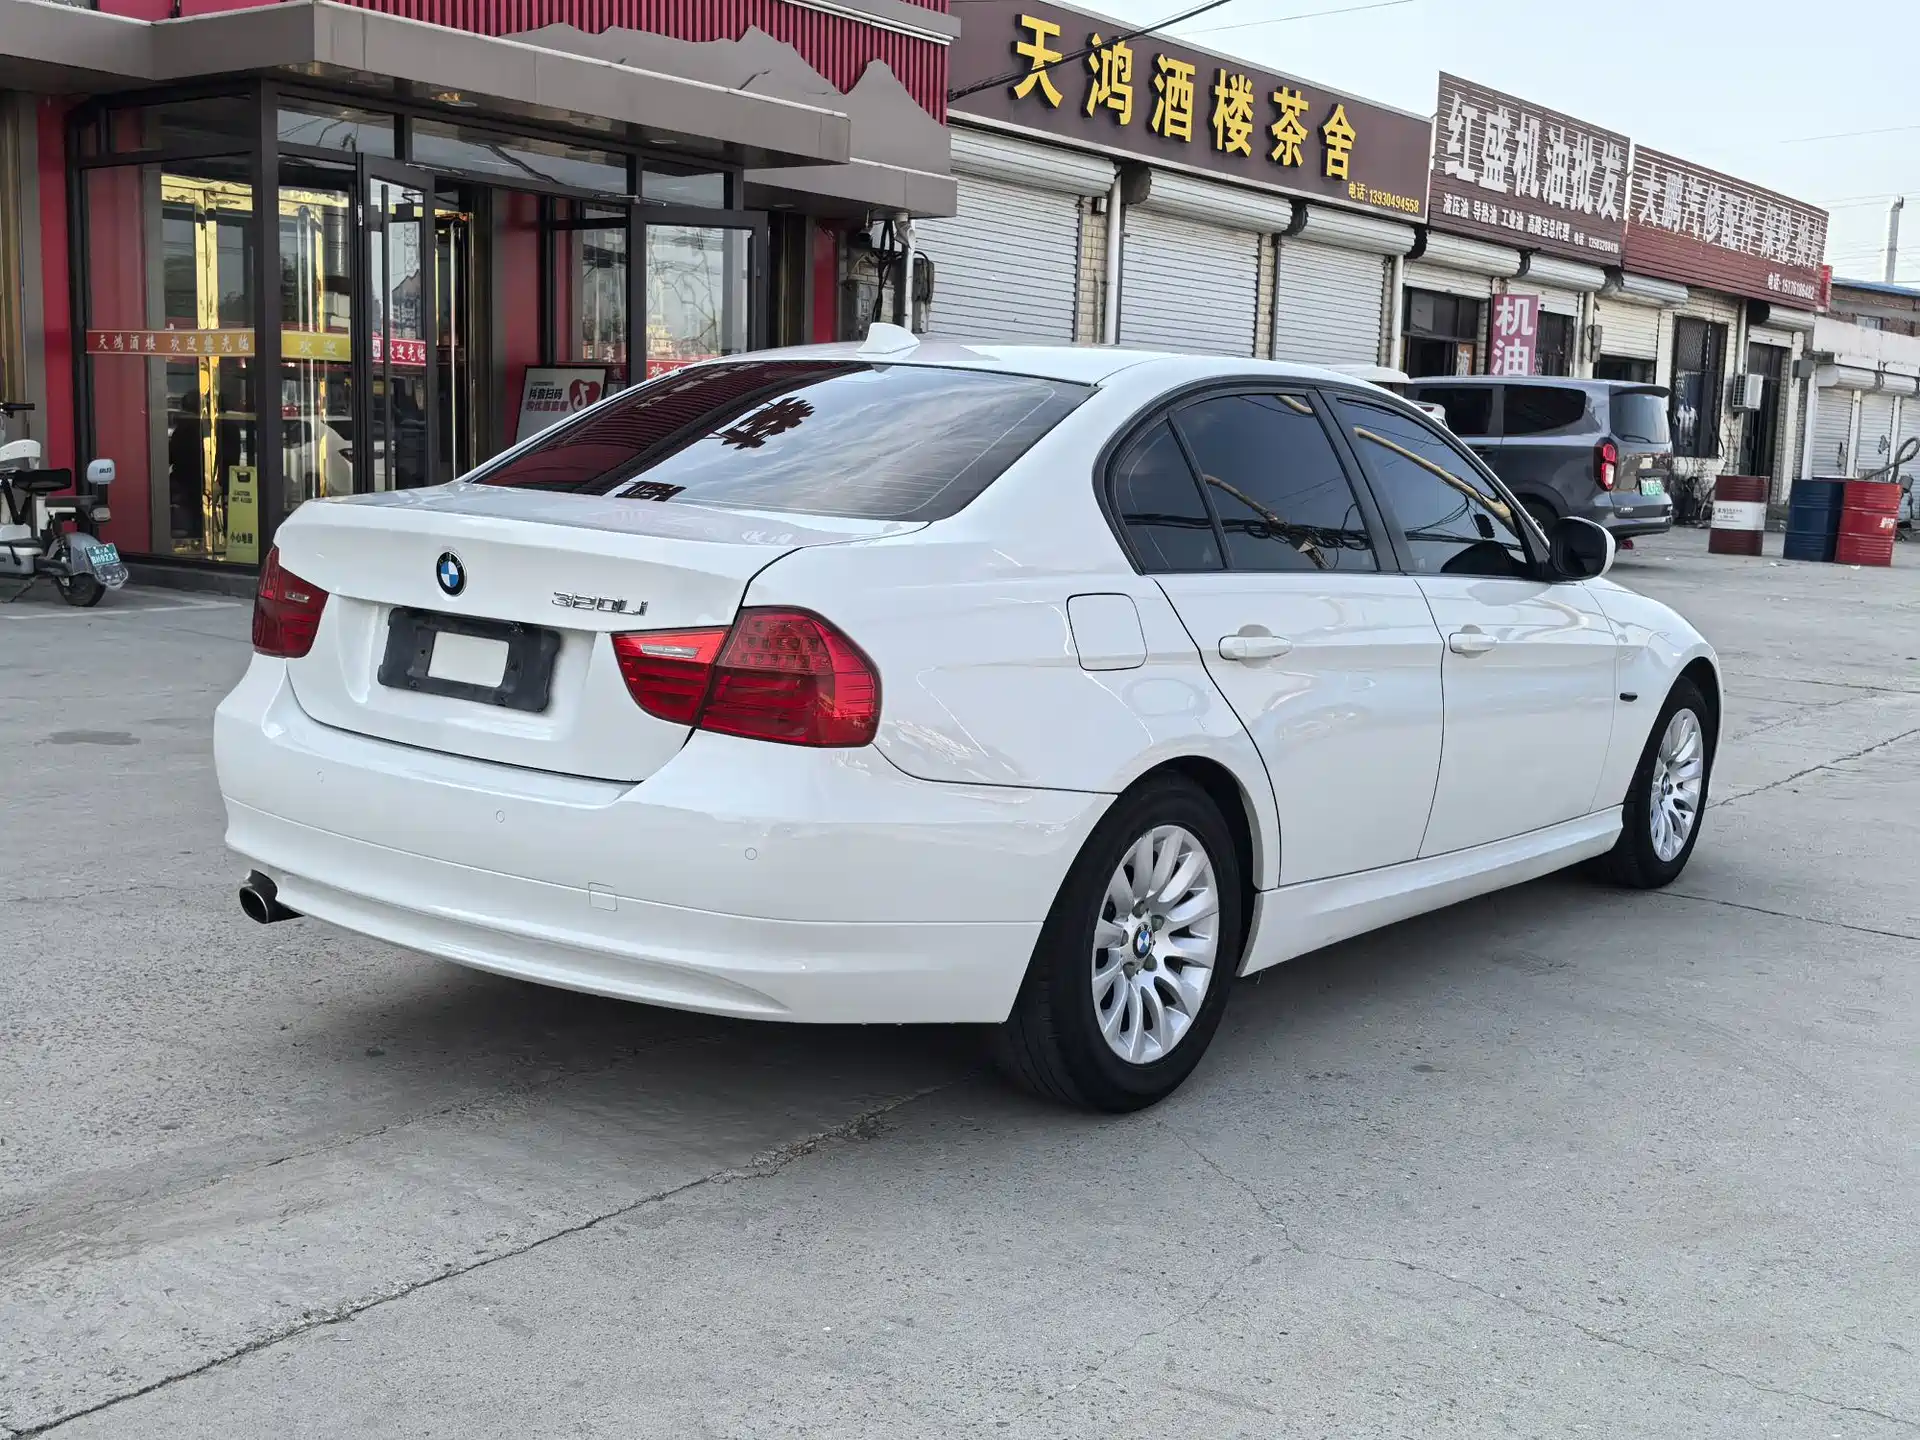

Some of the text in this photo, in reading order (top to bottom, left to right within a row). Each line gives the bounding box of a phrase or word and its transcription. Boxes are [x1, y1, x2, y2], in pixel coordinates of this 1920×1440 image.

[1013, 14, 1356, 181] 天鸿酒楼茶舍
[1445, 93, 1622, 222] 红盛机油批发
[1443, 193, 1469, 219] 液压油
[1501, 209, 1524, 232] 工业油
[98, 333, 156, 351] 天鸿酒楼
[1492, 297, 1533, 376] 机油
